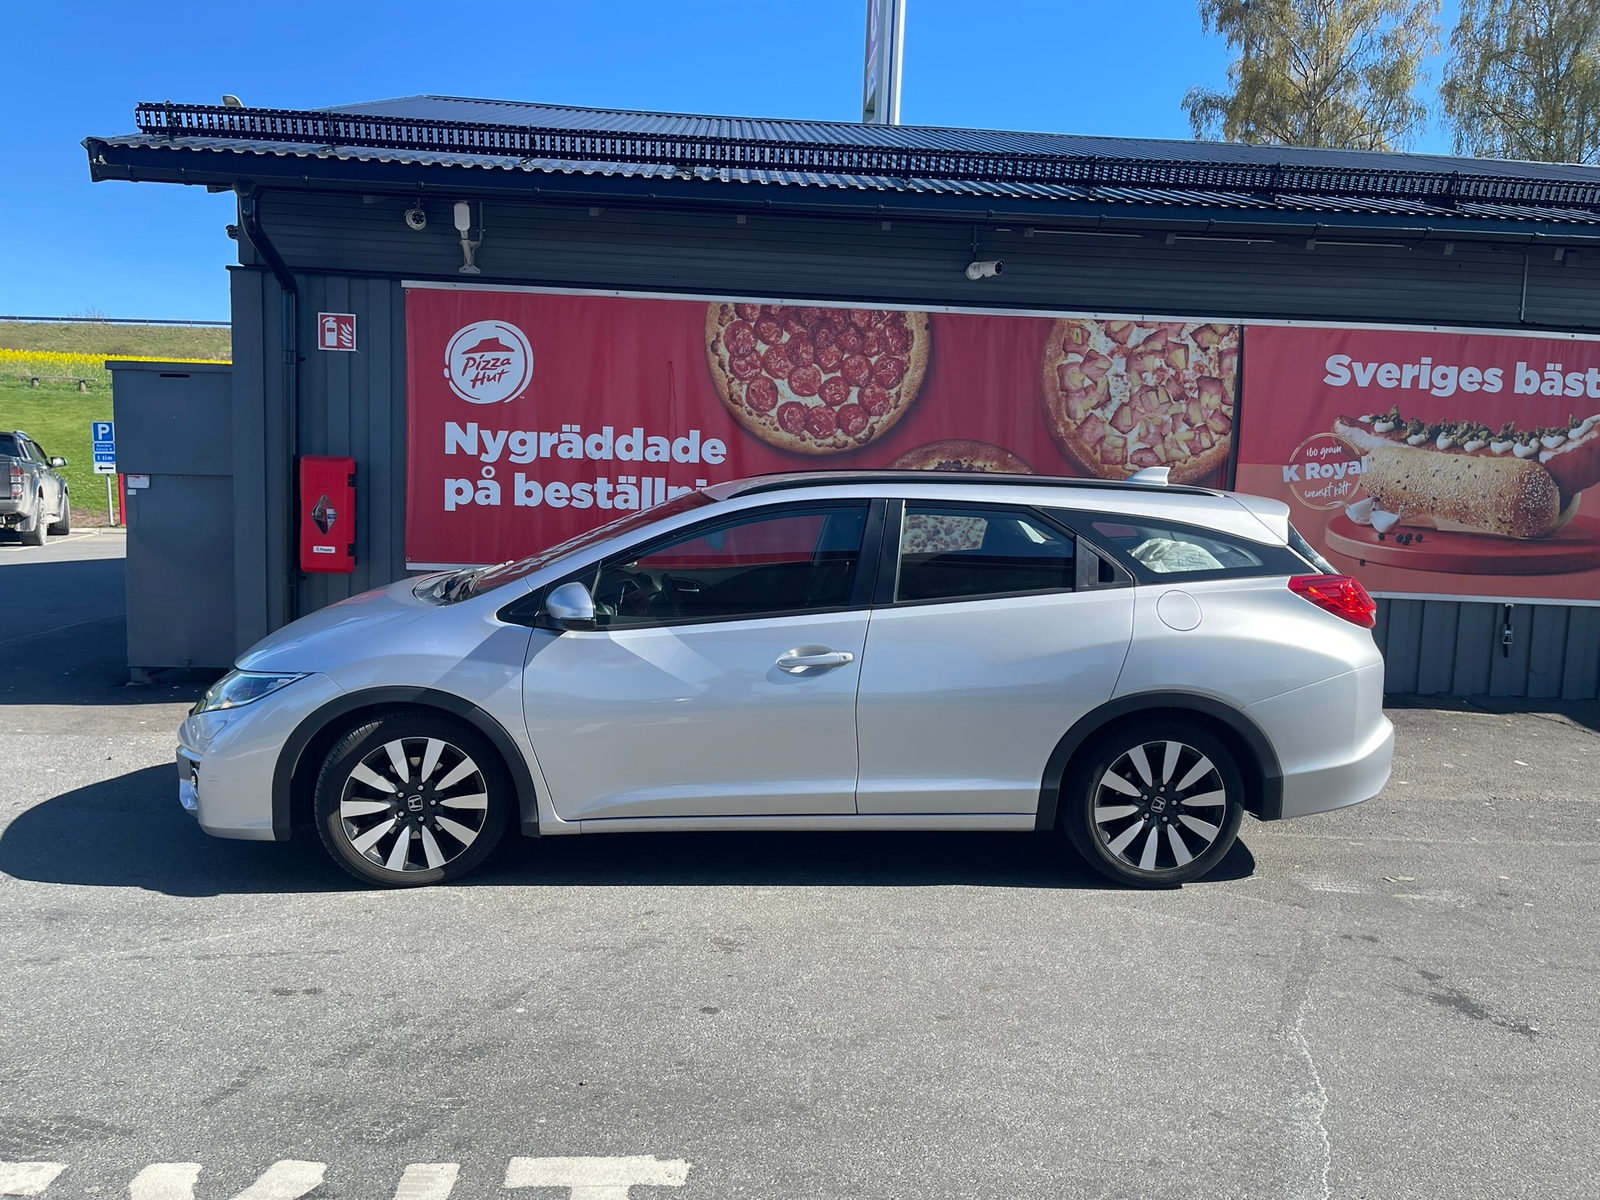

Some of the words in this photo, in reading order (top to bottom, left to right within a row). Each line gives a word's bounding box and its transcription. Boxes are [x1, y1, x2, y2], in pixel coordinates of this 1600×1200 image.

[461, 354, 512, 377] Pizza
[1323, 355, 1504, 397] Sveriges
[1514, 362, 1600, 398] bäst
[470, 369, 510, 389] Hut
[97, 423, 110, 440] P
[444, 421, 727, 464] Nygräddade
[1306, 448, 1319, 457] 160
[1320, 445, 1342, 460] gram
[1282, 464, 1301, 483] K
[1305, 455, 1368, 480] Royal
[444, 466, 501, 512] på
[515, 472, 708, 510] beställ
[1304, 482, 1334, 498] svenskt
[1333, 480, 1352, 497] kött
